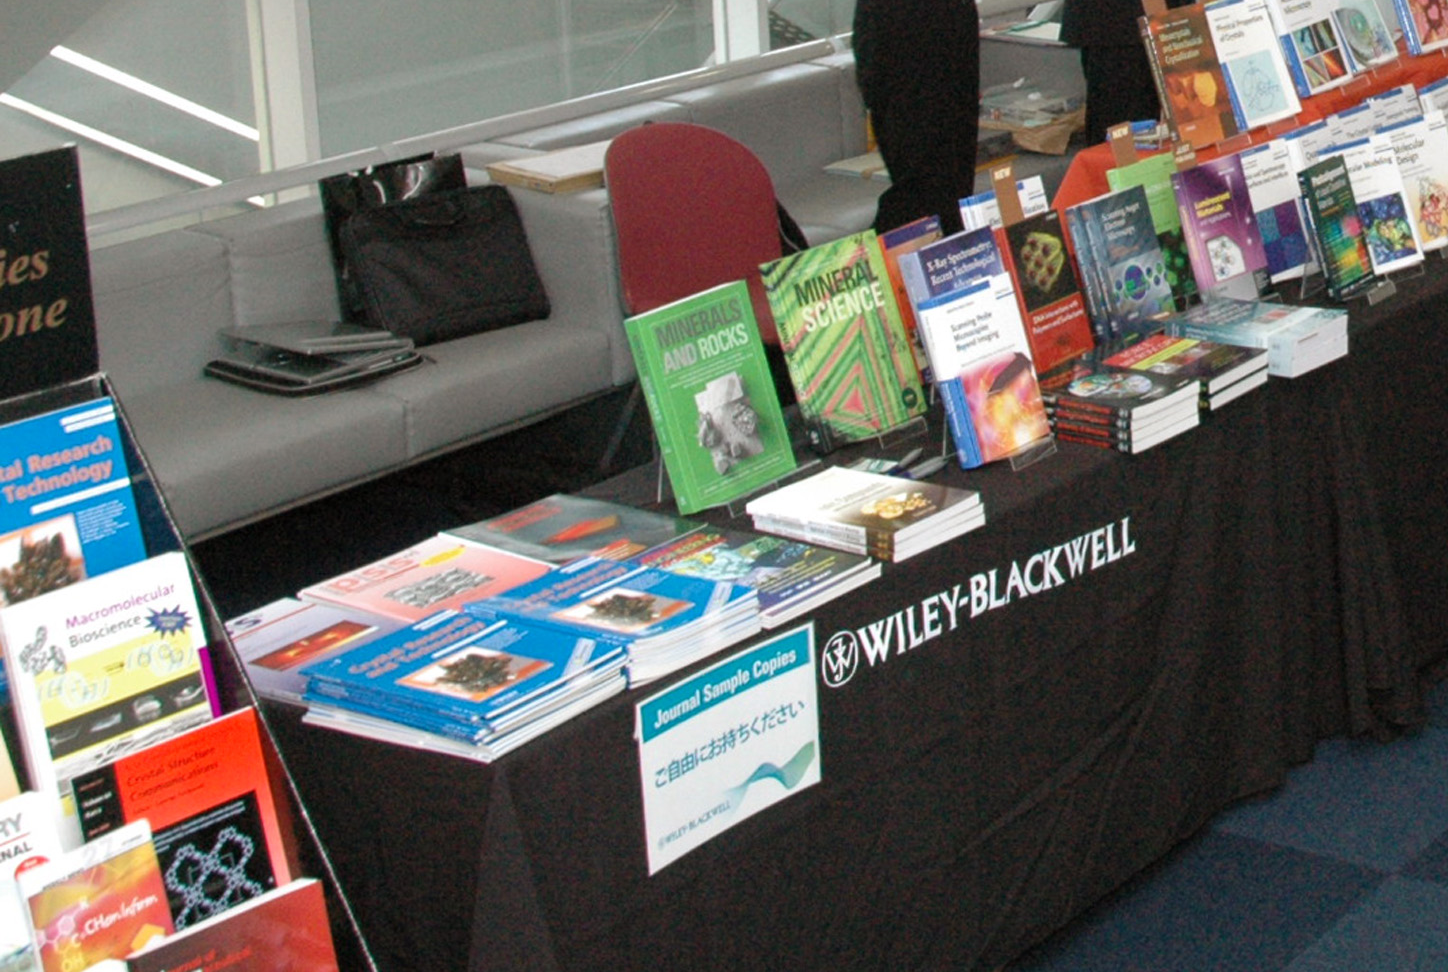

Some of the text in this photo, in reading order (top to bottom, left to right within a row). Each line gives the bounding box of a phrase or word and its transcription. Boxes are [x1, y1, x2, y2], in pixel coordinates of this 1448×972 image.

[793, 259, 880, 307] MINERAL
[801, 281, 886, 333] SCIENCE
[0, 298, 68, 342] one
[653, 297, 742, 348] MINERALS
[663, 343, 698, 375] AND
[698, 323, 749, 360] ROCKS
[27, 434, 113, 474] Research
[3, 459, 113, 504] Technology
[65, 583, 175, 629] Macromolecular
[856, 516, 1136, 668] WILEY-BLACKWELL
[68, 614, 142, 649] Bioscience
[654, 649, 797, 729] Journal Sample Copies
[654, 699, 806, 789] ご自由にお持ちください
